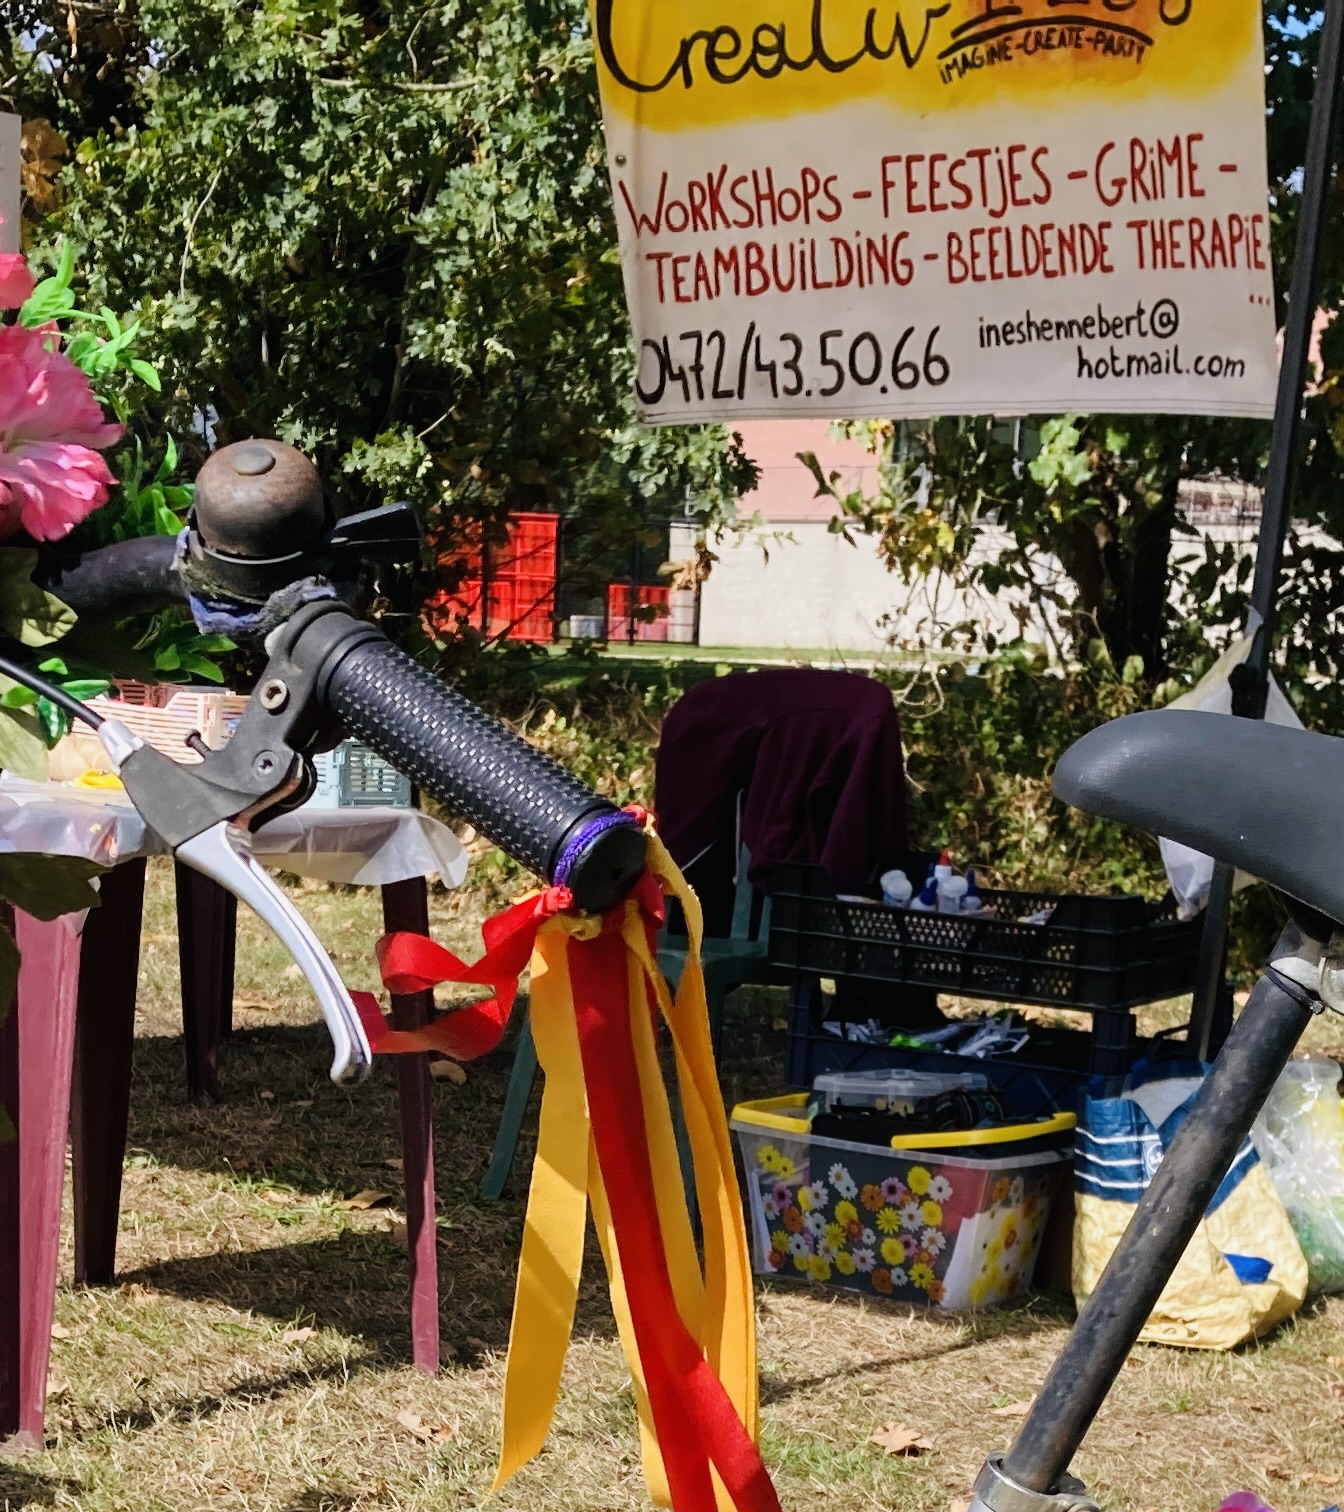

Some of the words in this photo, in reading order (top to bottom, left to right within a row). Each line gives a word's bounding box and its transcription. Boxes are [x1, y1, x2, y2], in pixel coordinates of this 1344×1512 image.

[947, 221, 1114, 283] BEELDENDE
[979, 298, 1178, 348] ineshennebert@
[635, 320, 950, 405] 0472/43.50.66
[1077, 344, 1245, 378] hotmail.com
